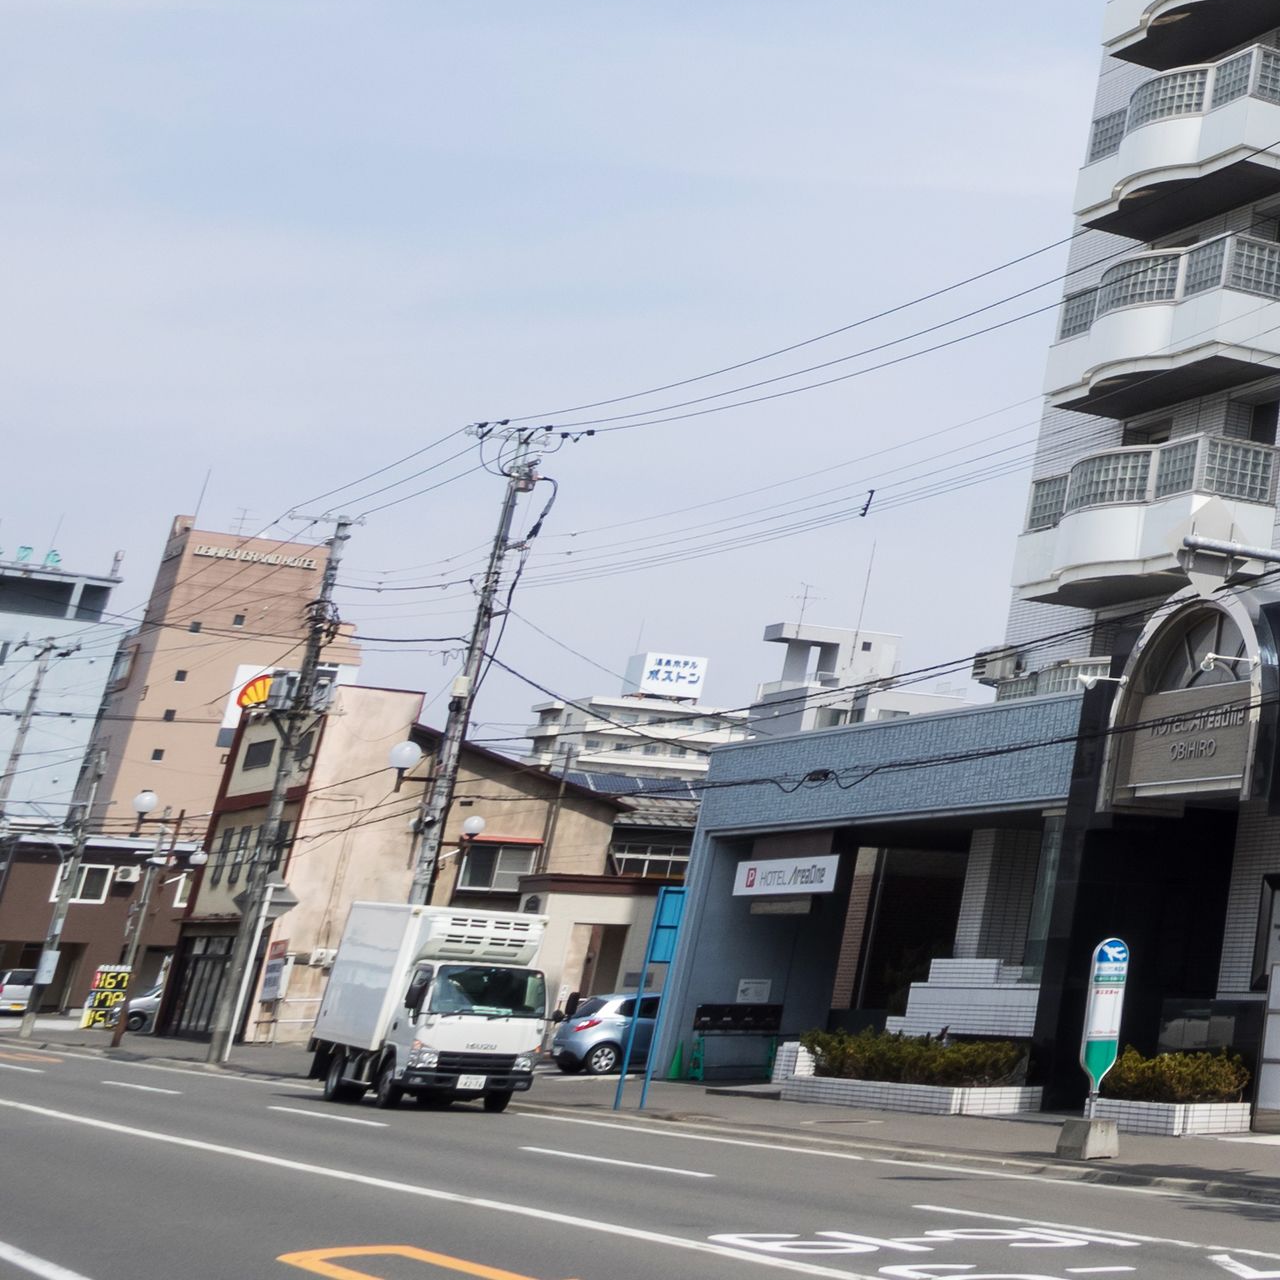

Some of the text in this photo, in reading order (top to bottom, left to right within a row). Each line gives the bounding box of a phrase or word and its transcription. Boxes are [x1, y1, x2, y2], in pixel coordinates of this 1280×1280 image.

[193, 544, 318, 570] OBIHIRO GRAND HOTEL
[646, 669, 700, 684] ボストン
[1168, 738, 1217, 760] OBIHIRO
[760, 870, 787, 887] HOTEL
[787, 865, 826, 885] AreaOne
